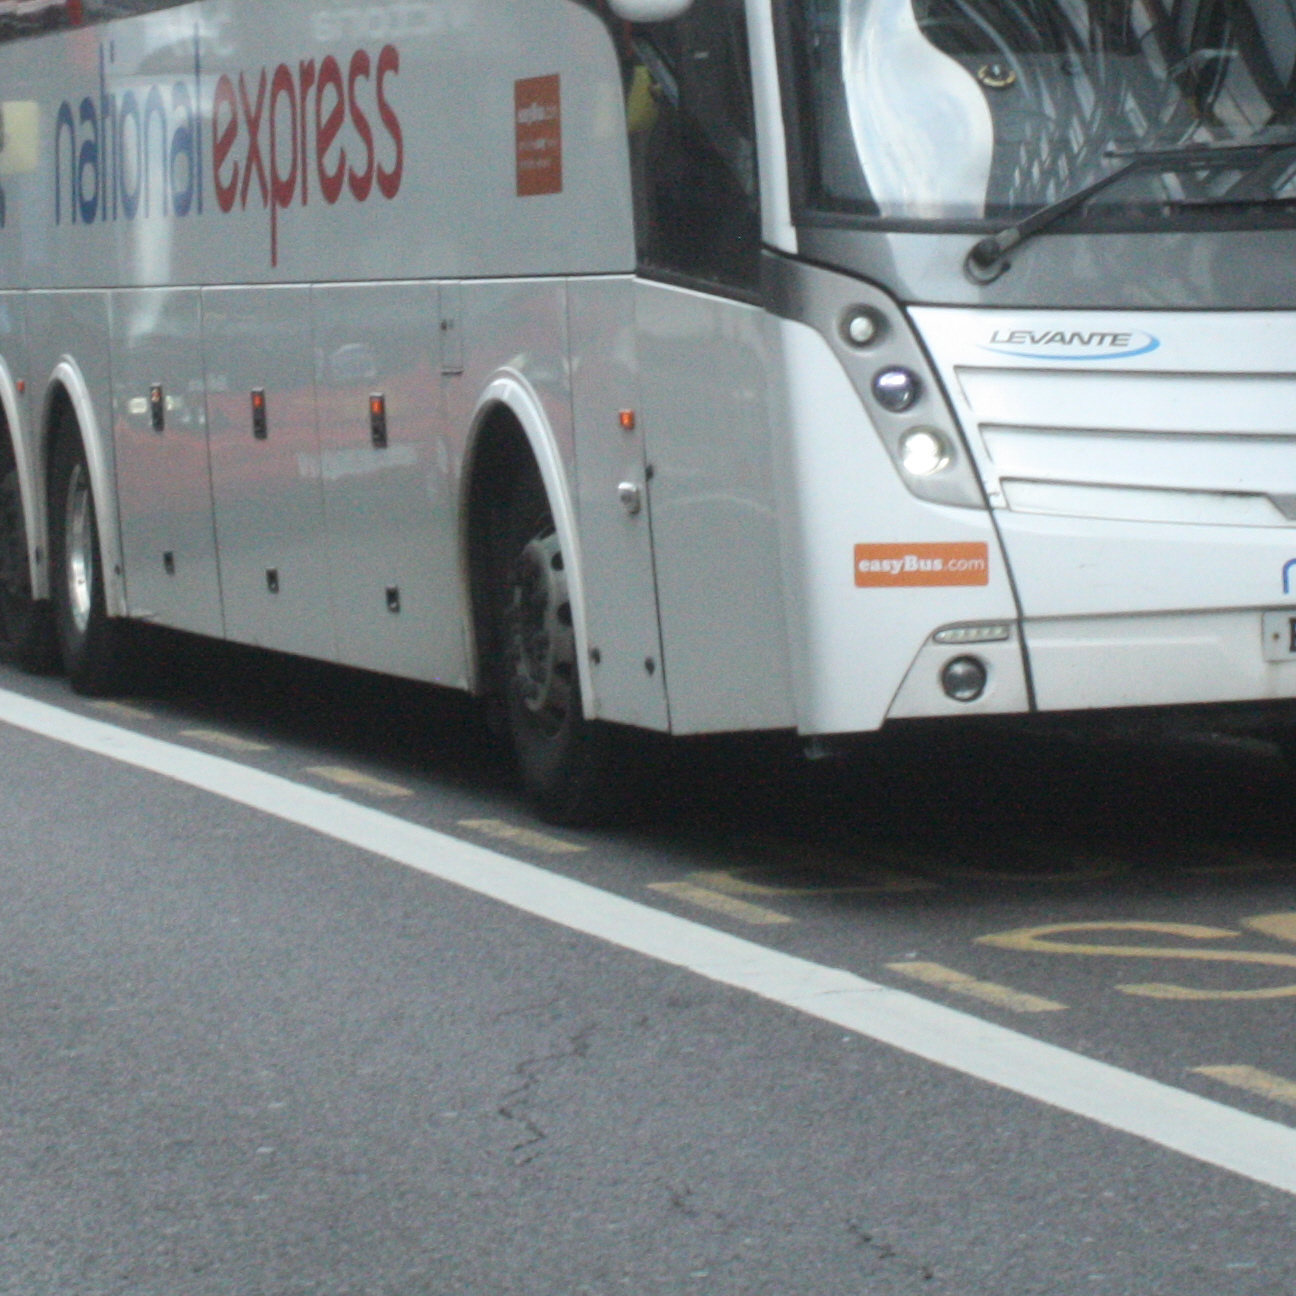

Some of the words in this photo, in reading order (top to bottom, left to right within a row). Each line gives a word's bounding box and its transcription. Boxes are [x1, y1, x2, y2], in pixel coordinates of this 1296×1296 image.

[55, 22, 203, 225] national
[212, 44, 404, 267] express
[989, 329, 1132, 348] LEVANTE
[858, 555, 986, 575] easyBus.com
